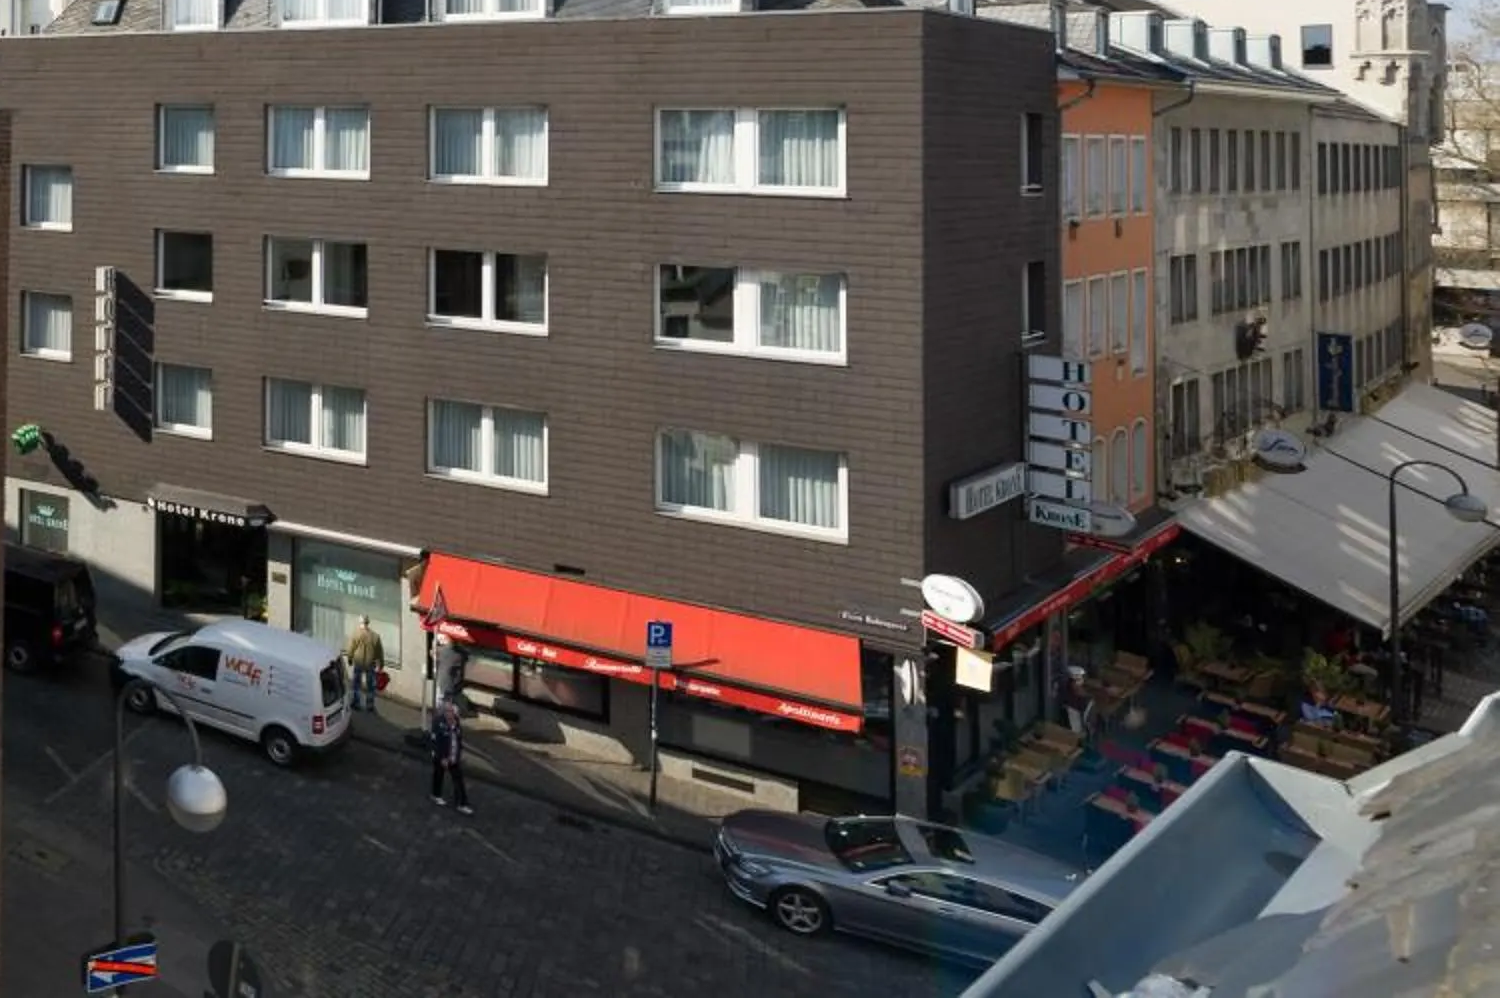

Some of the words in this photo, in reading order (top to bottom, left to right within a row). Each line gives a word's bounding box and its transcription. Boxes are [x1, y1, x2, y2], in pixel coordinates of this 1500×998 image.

[1062, 361, 1086, 503] HOTEL
[157, 500, 195, 518] Hotel
[200, 505, 245, 527] Krone
[650, 624, 665, 645] P
